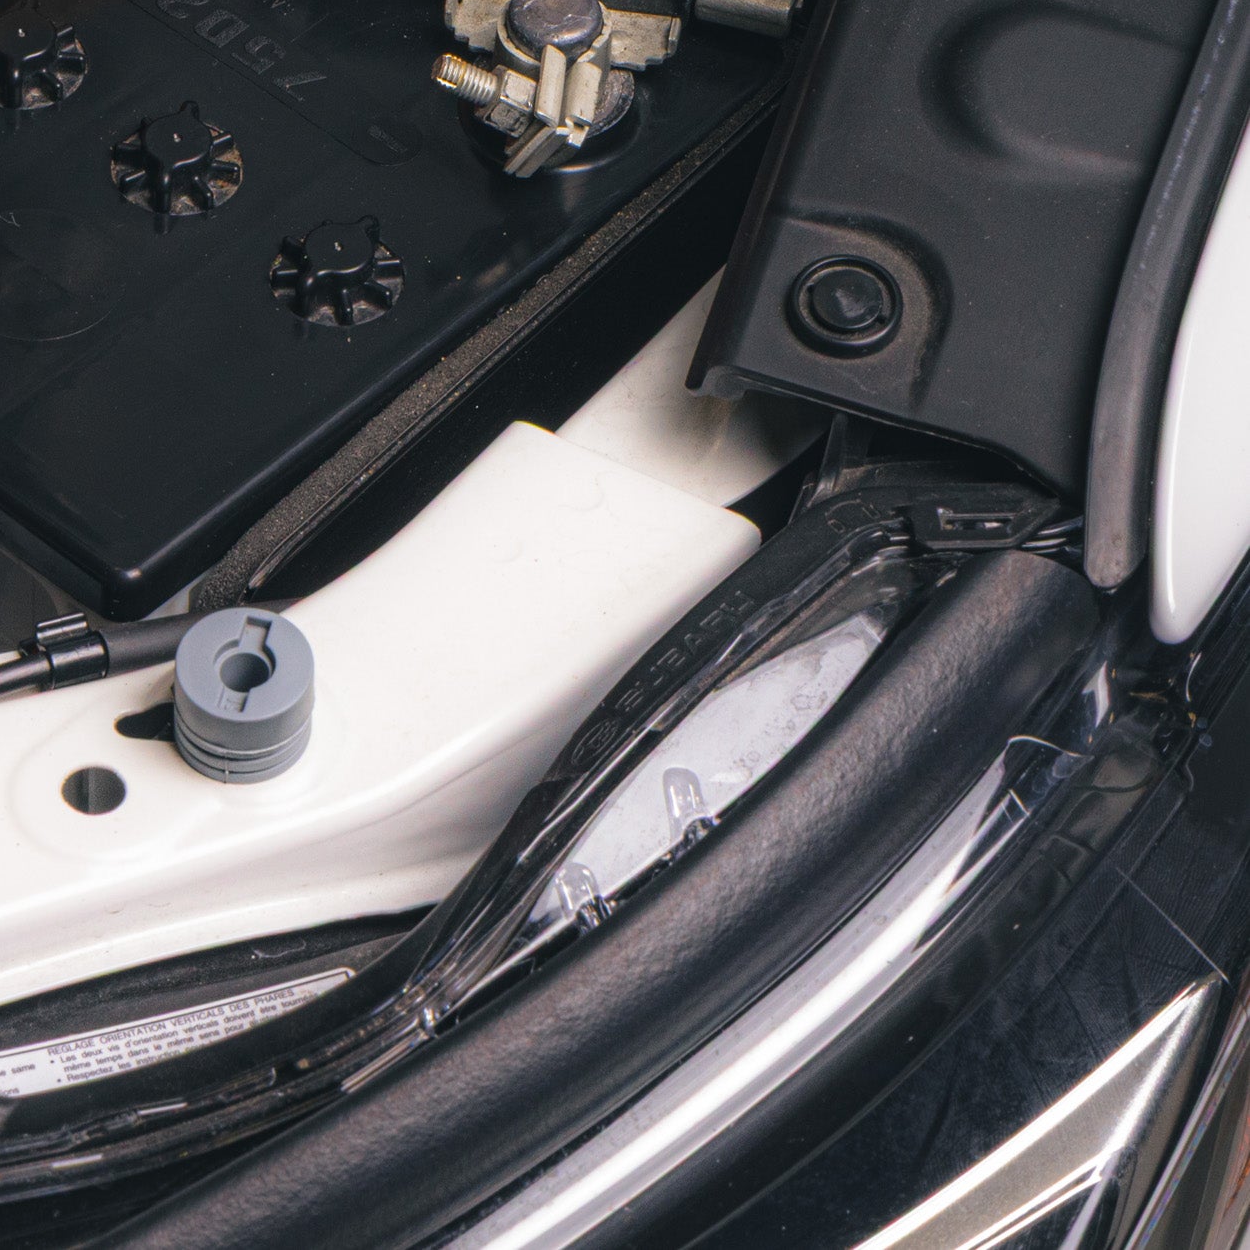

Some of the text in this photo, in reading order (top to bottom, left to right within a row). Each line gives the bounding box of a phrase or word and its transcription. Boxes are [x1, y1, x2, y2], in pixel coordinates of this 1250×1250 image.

[100, 1022, 166, 1044] ORIENTATION
[171, 1007, 225, 1026] VERTICALS
[229, 1000, 250, 1013] DES
[254, 989, 295, 1006] PHARES
[81, 1047, 103, 1060] deux
[11, 1062, 36, 1074] same
[66, 1065, 114, 1083] Respectez
